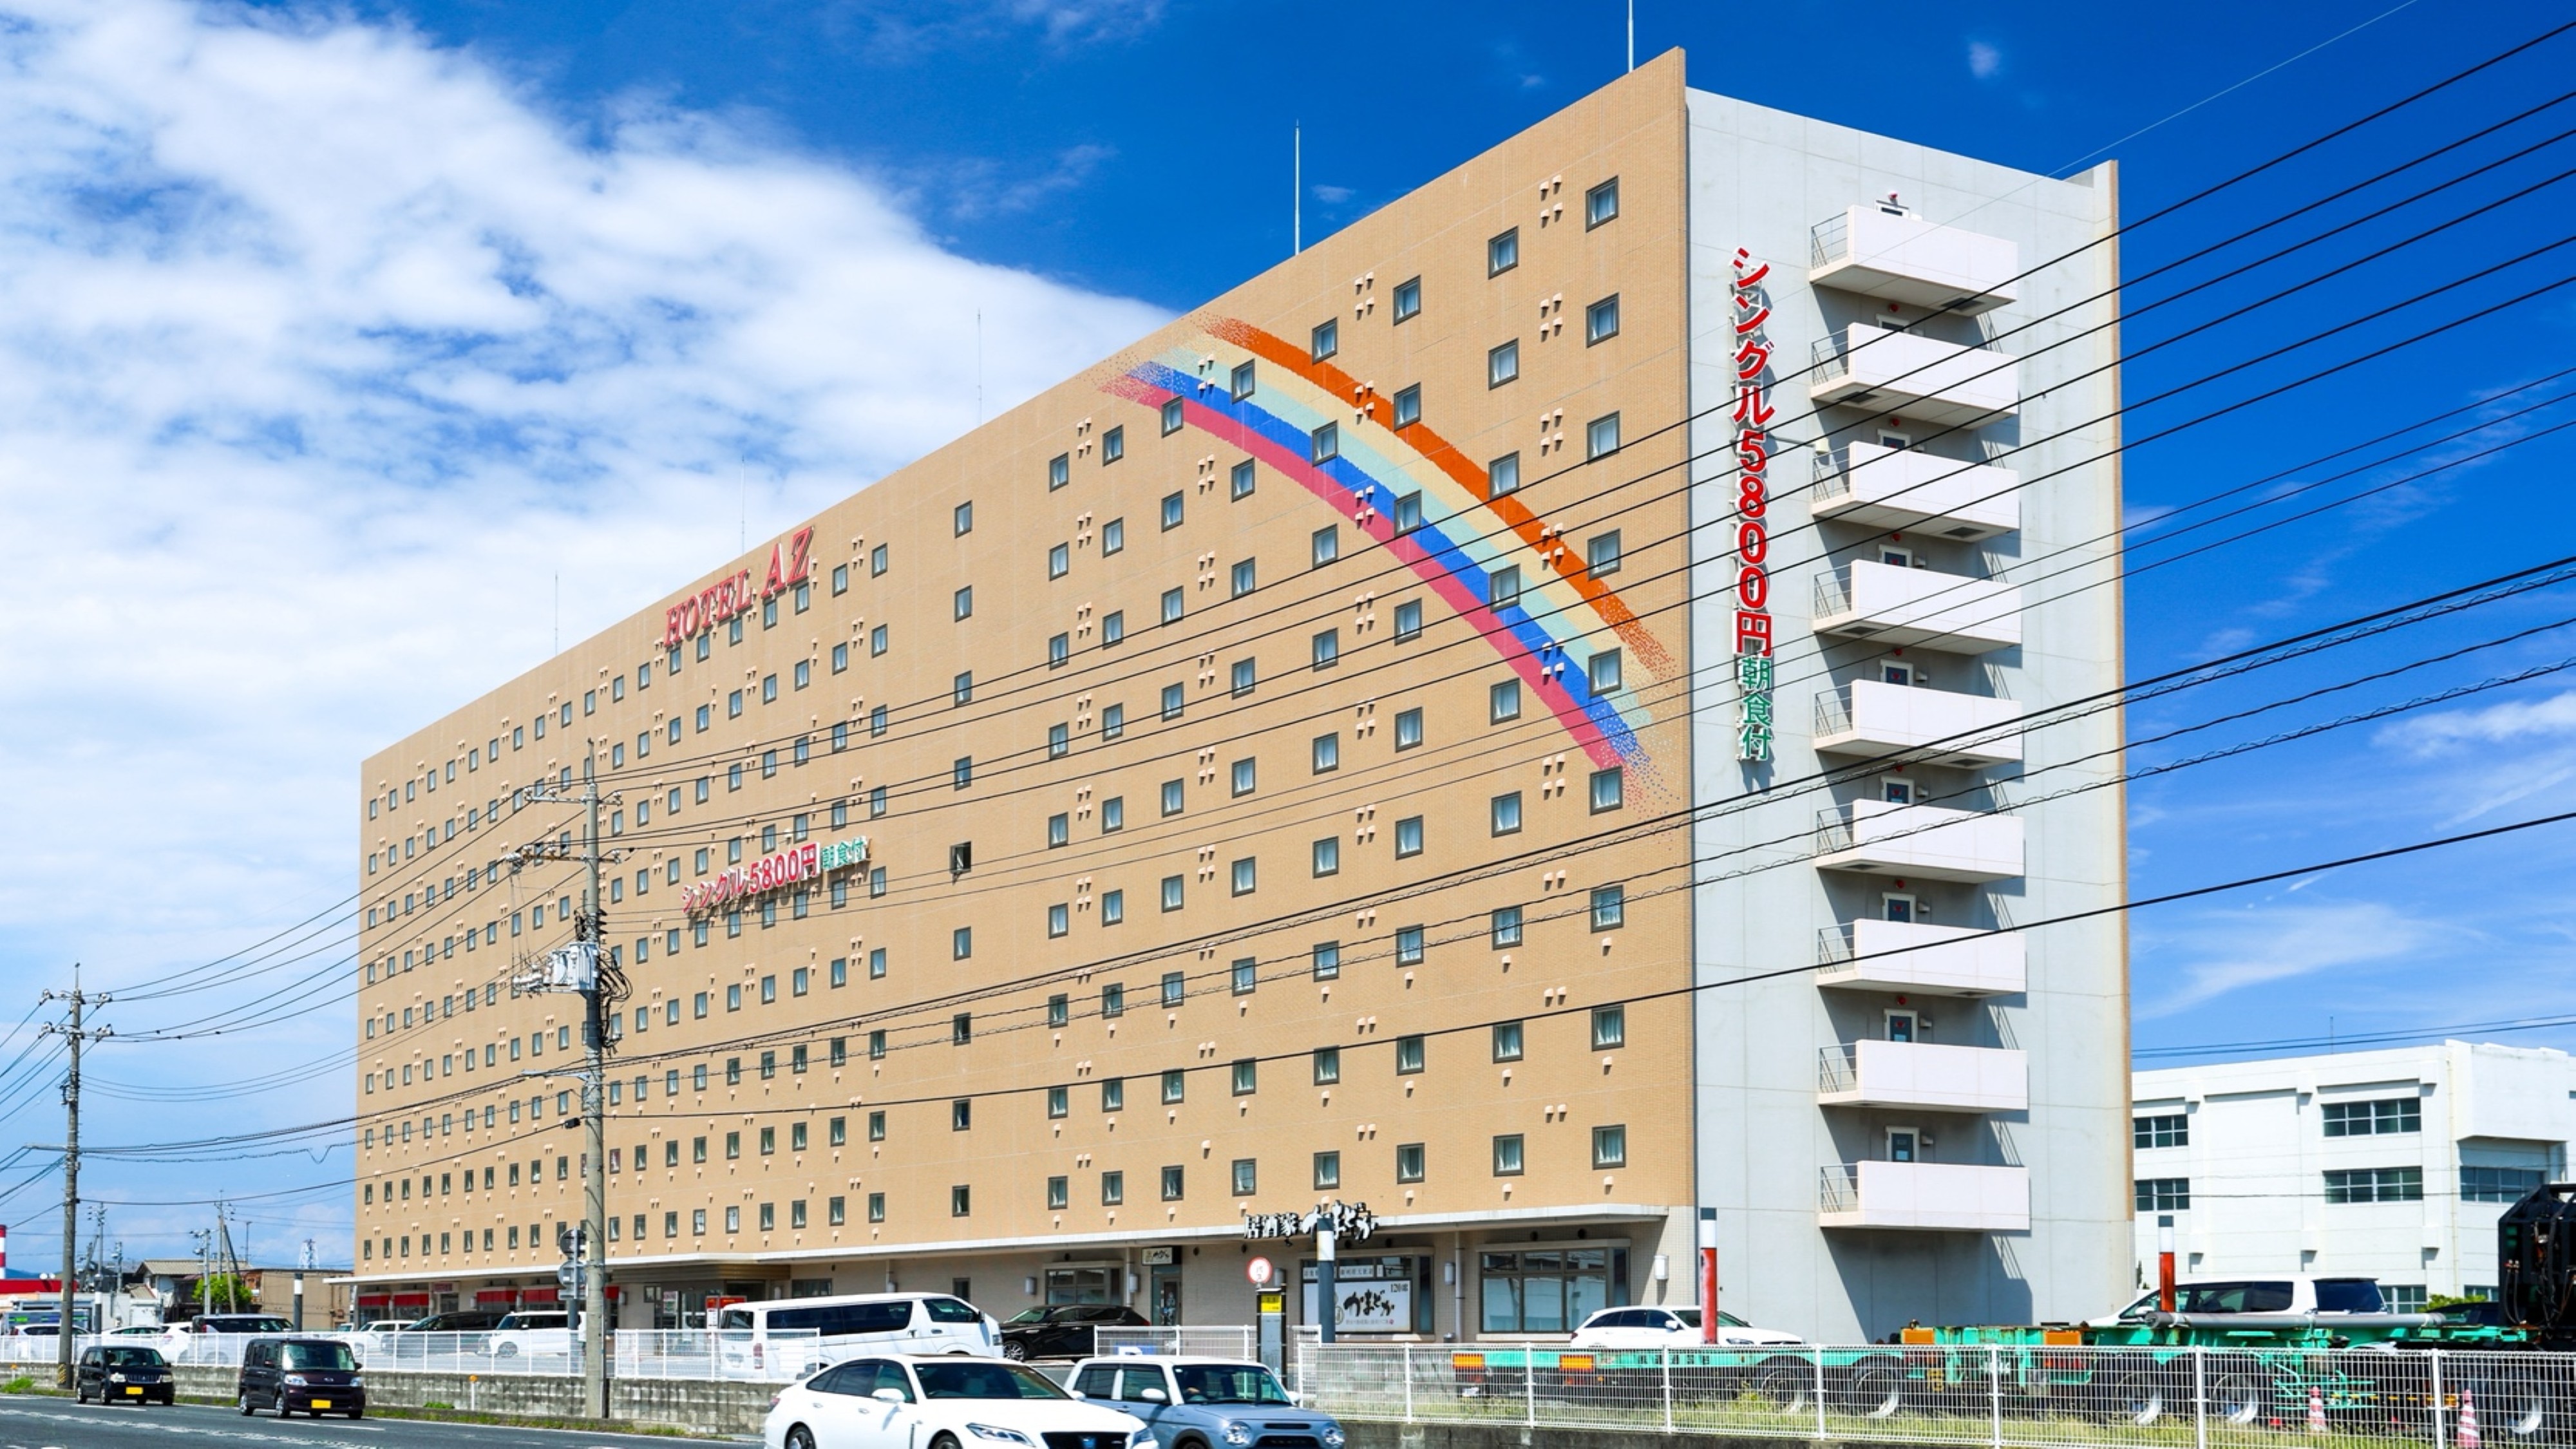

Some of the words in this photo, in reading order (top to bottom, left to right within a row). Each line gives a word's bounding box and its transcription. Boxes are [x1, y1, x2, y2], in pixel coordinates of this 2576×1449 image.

[1730, 246, 1776, 761] シングル5800円朝食付
[663, 568, 753, 648] HOTEL
[761, 526, 814, 600] AZ
[1343, 1289, 1395, 1317] かまどか
